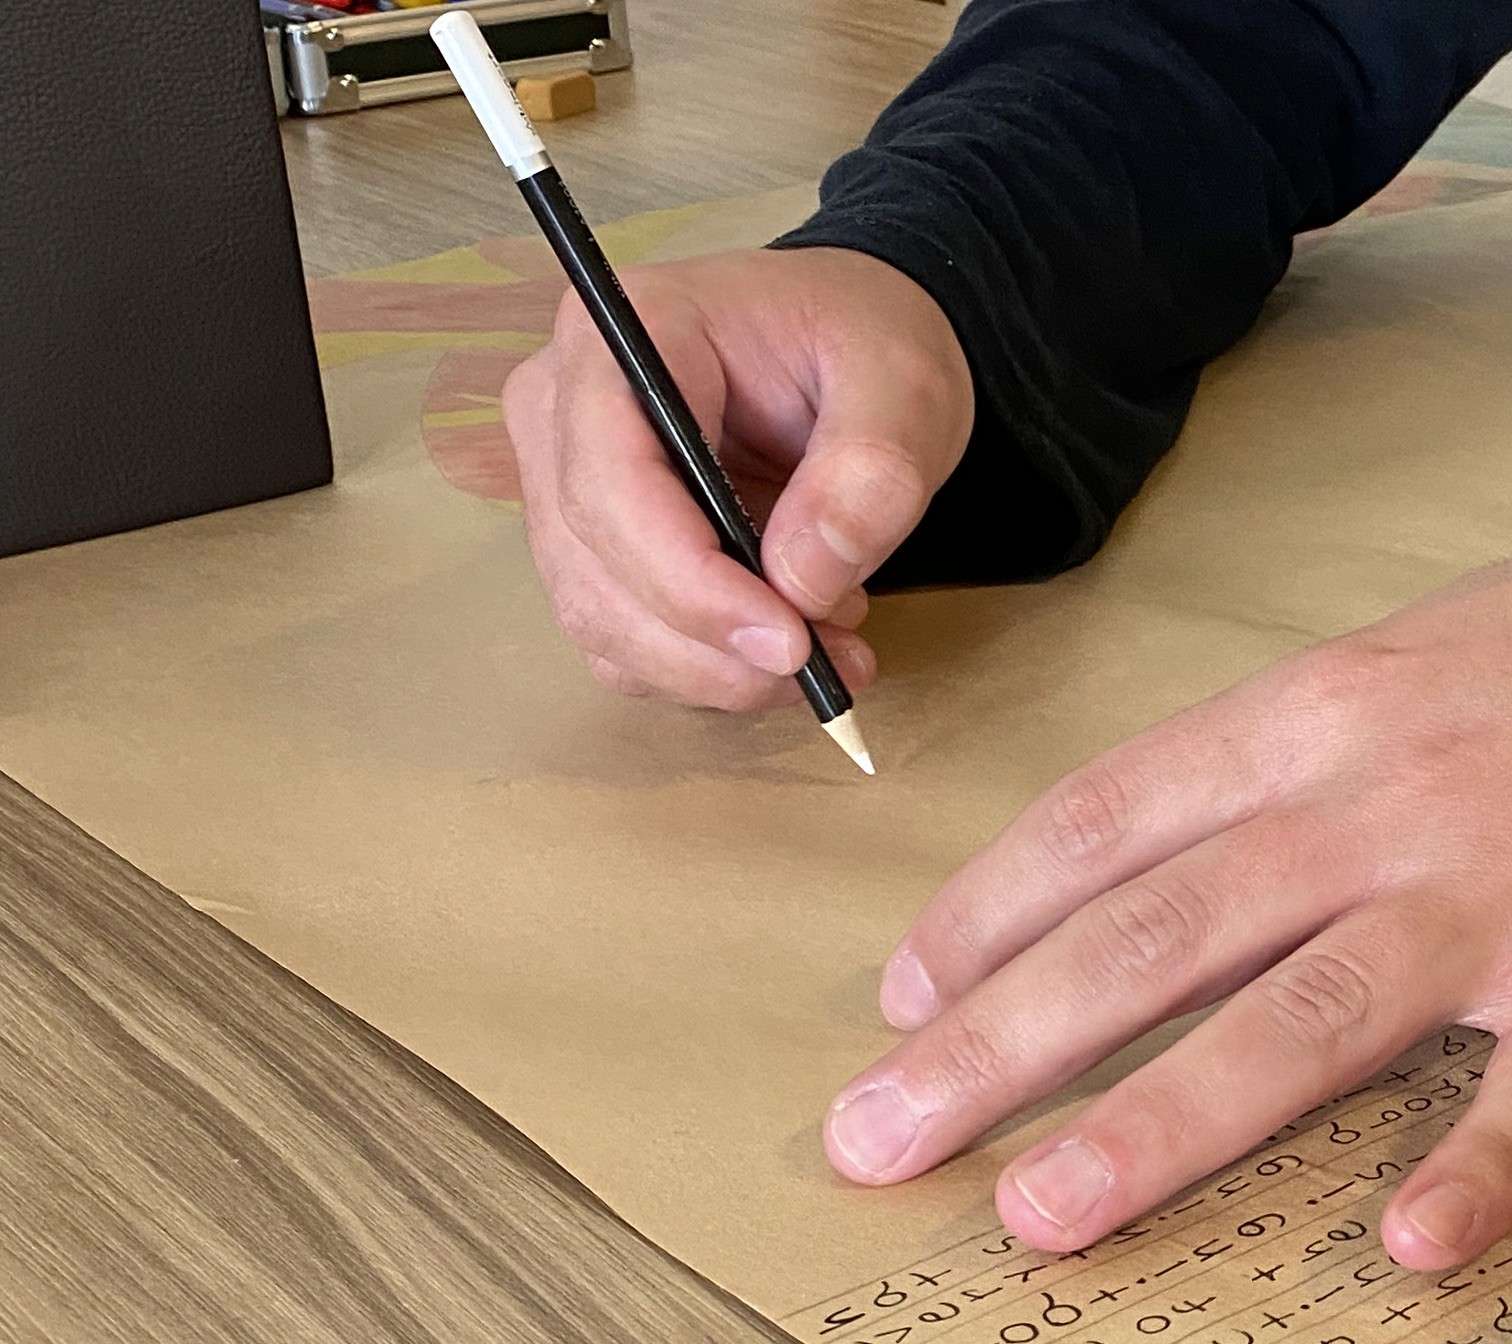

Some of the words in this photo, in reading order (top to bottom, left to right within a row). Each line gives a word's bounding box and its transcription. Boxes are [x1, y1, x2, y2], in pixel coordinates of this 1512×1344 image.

[1306, 1161, 1403, 1205] is
[1136, 1296, 1217, 1335] of
[1251, 1220, 1368, 1282] the
